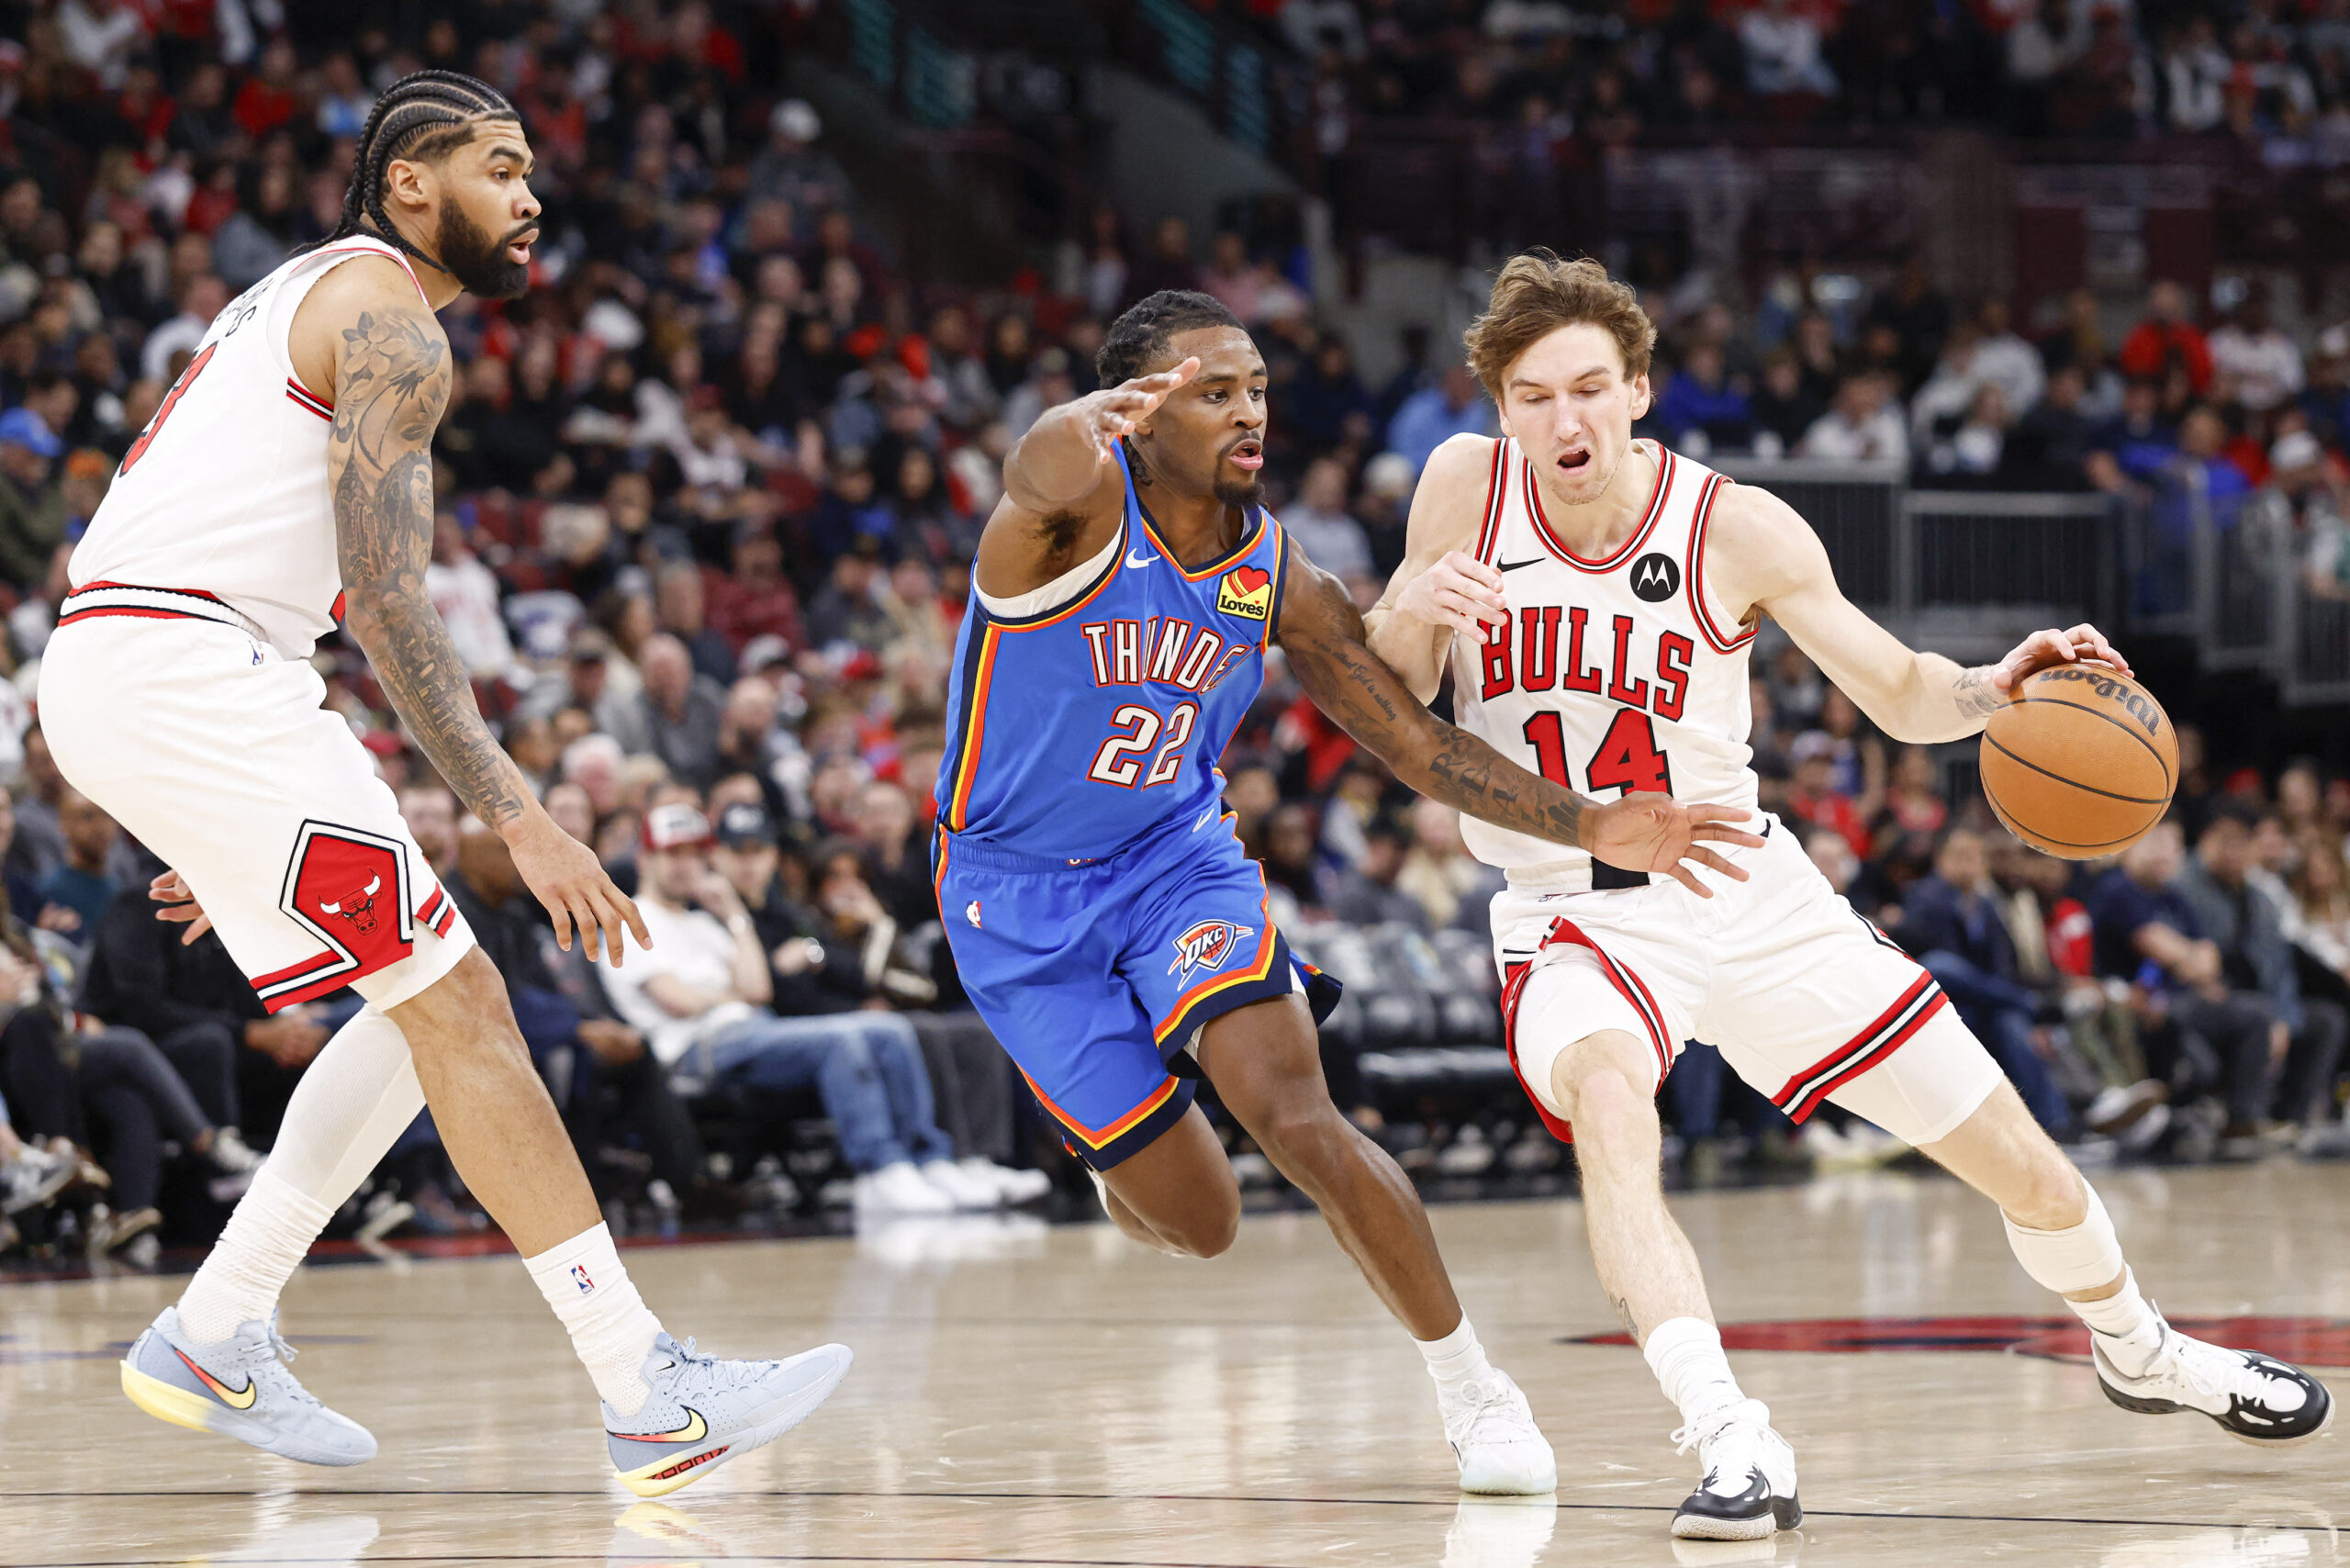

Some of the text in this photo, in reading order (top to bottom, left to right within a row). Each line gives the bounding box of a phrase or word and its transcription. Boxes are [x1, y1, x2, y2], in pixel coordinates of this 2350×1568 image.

[1080, 615, 1252, 696] THUNDE
[1348, 665, 1374, 686] God
[1461, 605, 1695, 723] BULLS
[2038, 668, 2160, 737] Wilson
[1086, 700, 1199, 792] 22
[1522, 707, 1674, 799] 14
[1183, 926, 1224, 973] OKC
